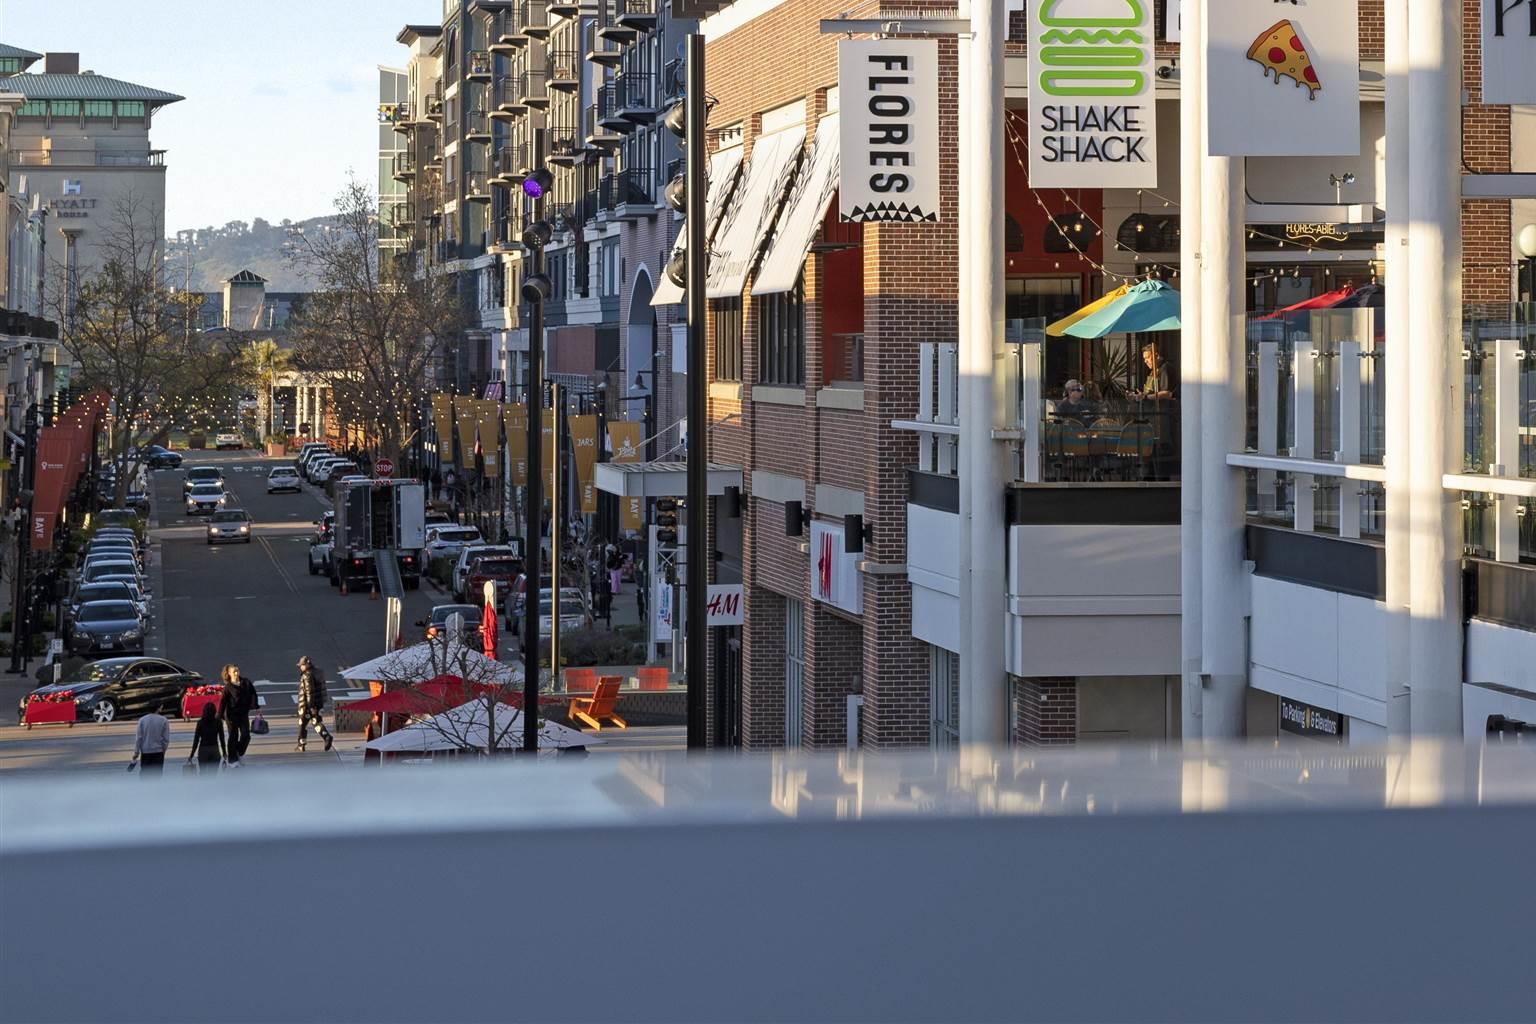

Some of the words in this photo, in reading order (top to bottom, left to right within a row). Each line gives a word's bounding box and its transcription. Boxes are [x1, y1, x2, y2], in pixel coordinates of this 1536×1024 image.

[868, 55, 910, 193] FLORES
[1041, 105, 1141, 132] SHAKE
[1041, 136, 1147, 163] SHACK
[49, 198, 97, 209] HYATT
[375, 463, 393, 472] STOP
